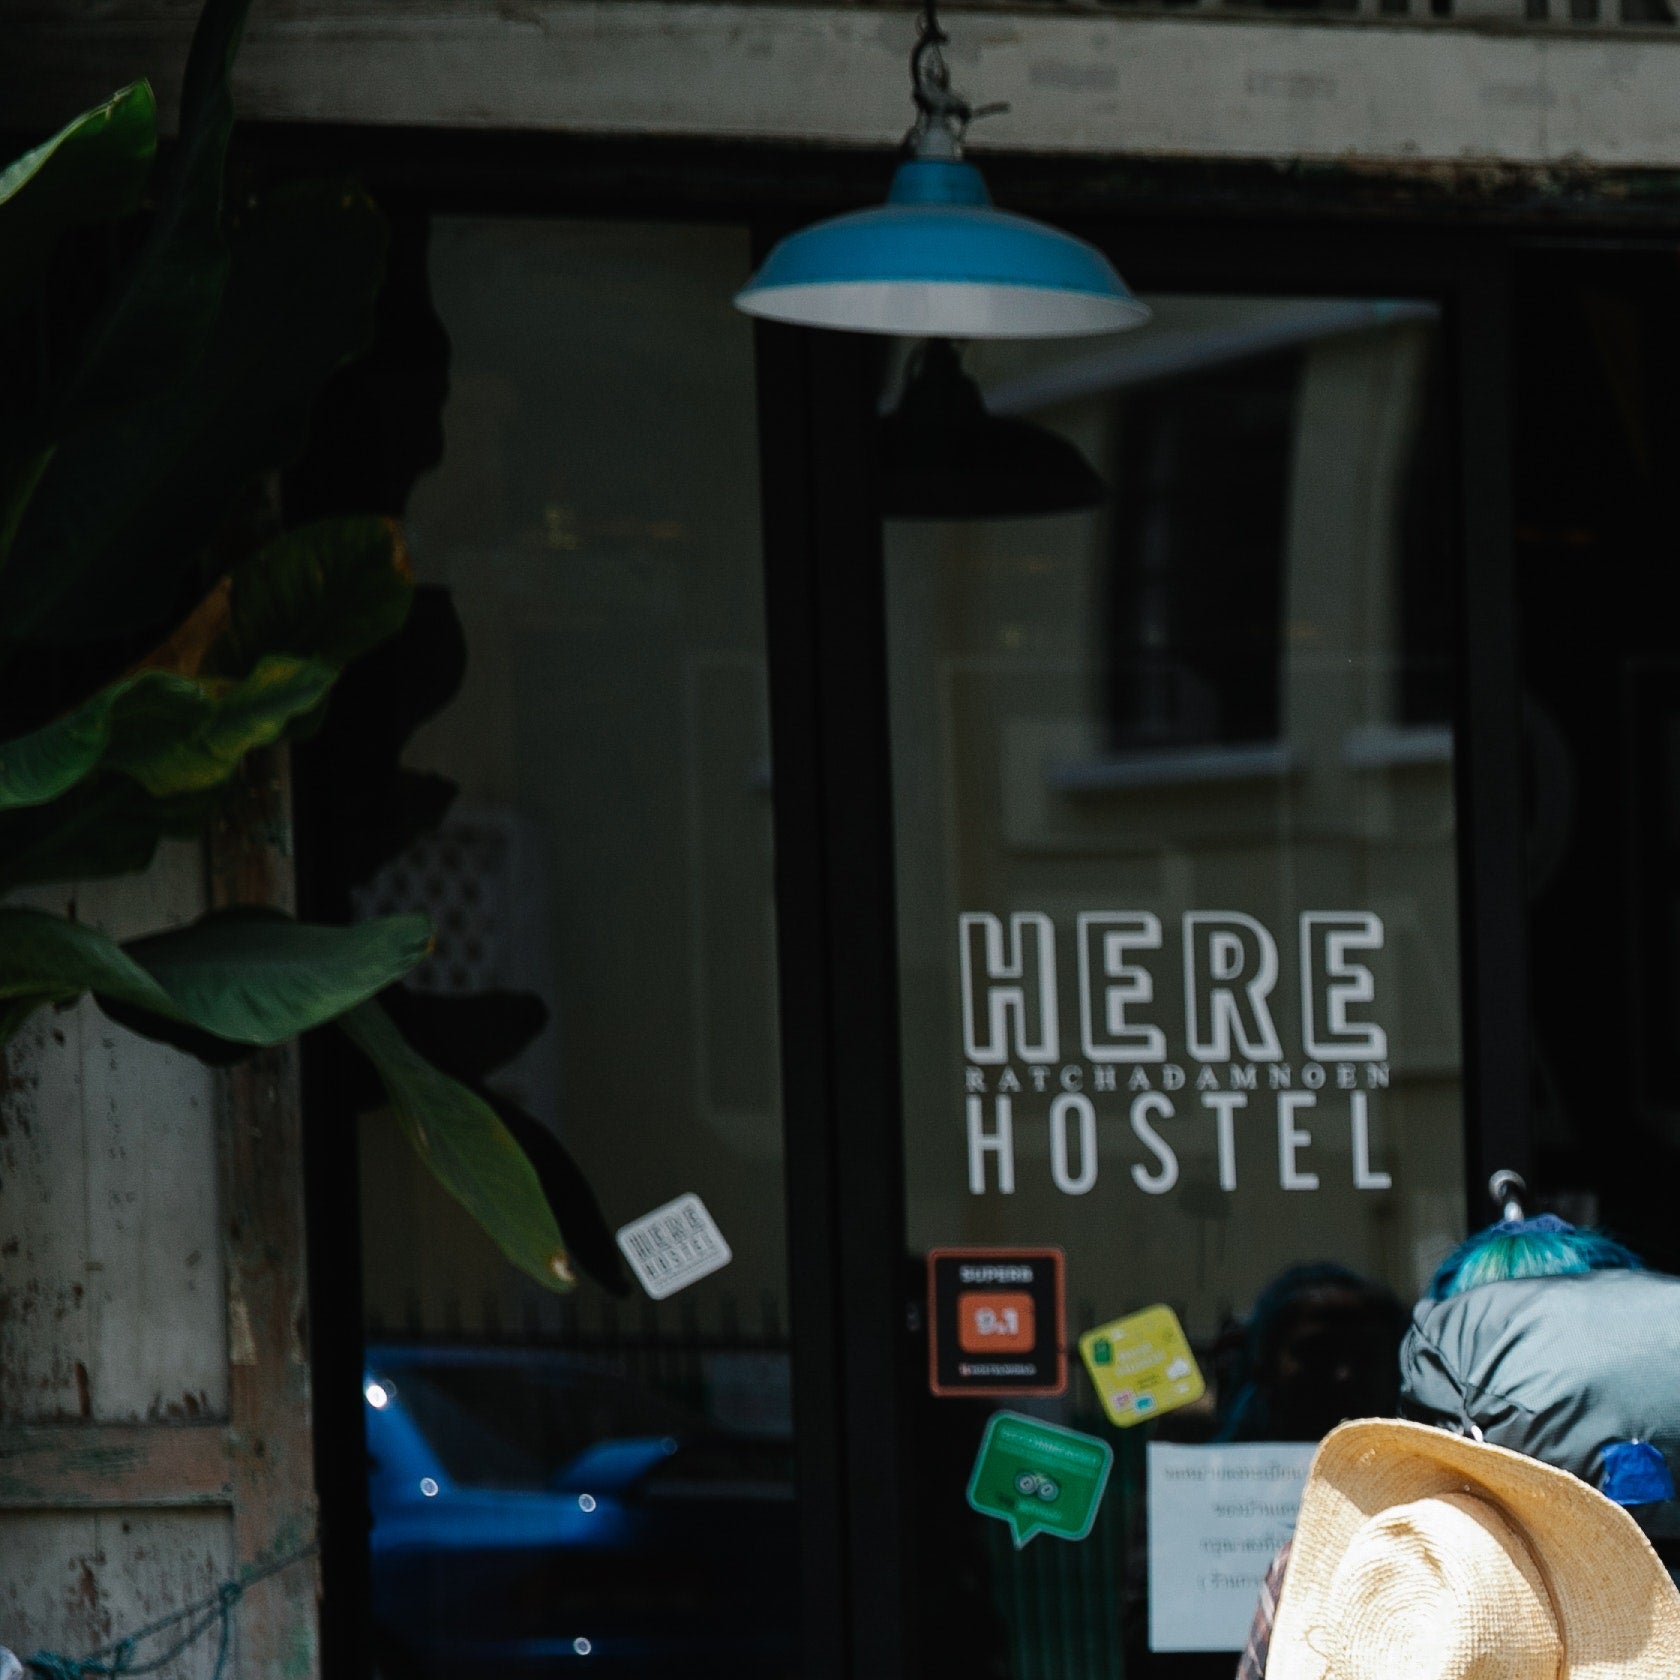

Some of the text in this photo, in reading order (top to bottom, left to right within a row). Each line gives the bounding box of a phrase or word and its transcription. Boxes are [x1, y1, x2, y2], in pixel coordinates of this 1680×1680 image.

[959, 909, 1388, 1064] HERE
[964, 1062, 1391, 1093] RATCHADAMNOEN
[965, 1089, 1393, 1195] HOSTEL
